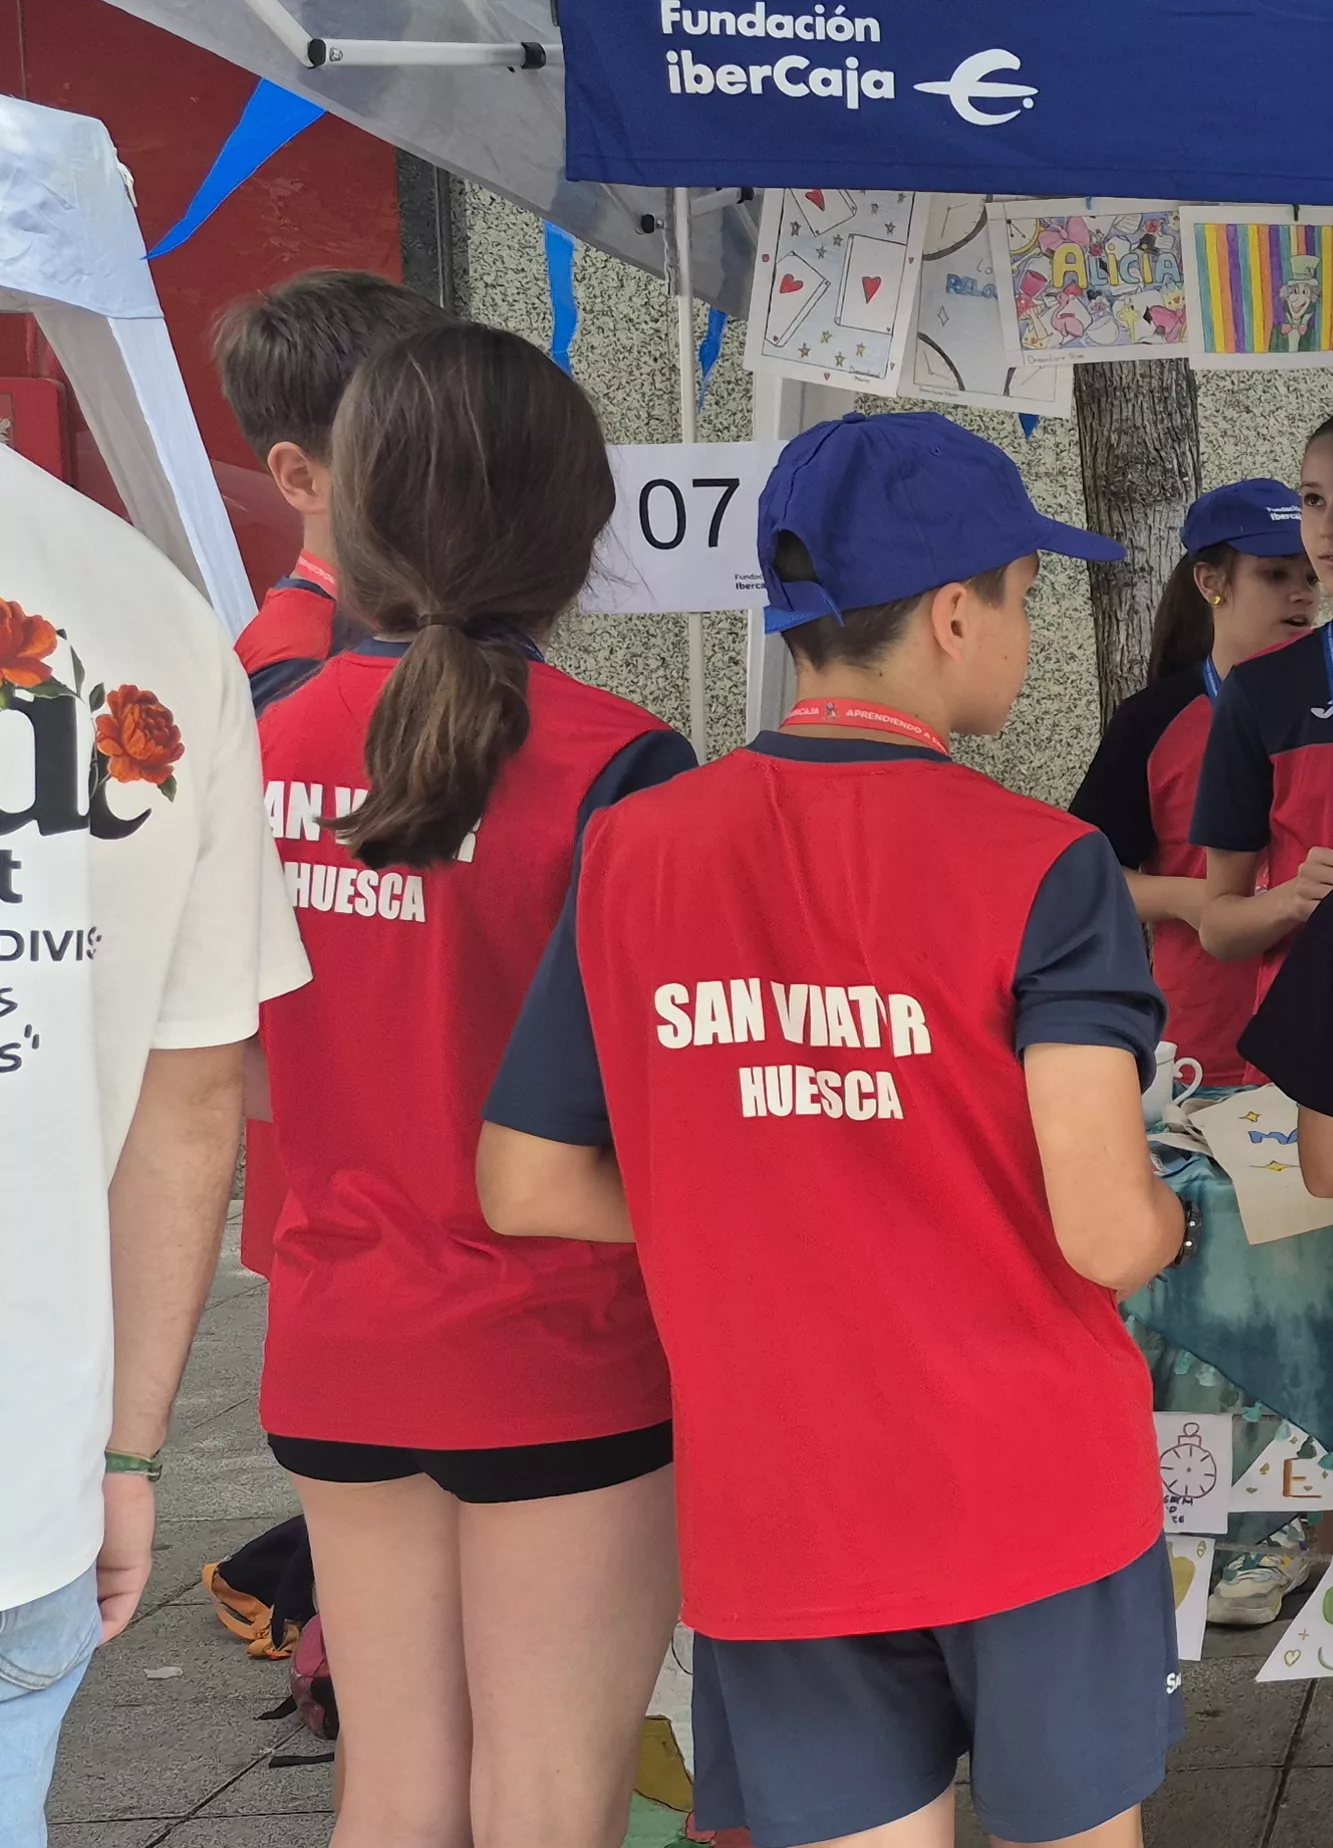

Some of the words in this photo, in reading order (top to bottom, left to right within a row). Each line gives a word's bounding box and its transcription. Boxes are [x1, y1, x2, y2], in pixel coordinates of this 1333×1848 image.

[660, 0, 881, 42] Fundación
[666, 49, 896, 110] iberCaja
[638, 477, 740, 550] 07
[846, 708, 922, 735] APRENDIENDO
[284, 861, 426, 923] HUESCA
[654, 977, 766, 1050] SAN
[770, 980, 932, 1058] VIATR
[738, 1064, 904, 1121] HUESCA
[1282, 1457, 1323, 1498] E
